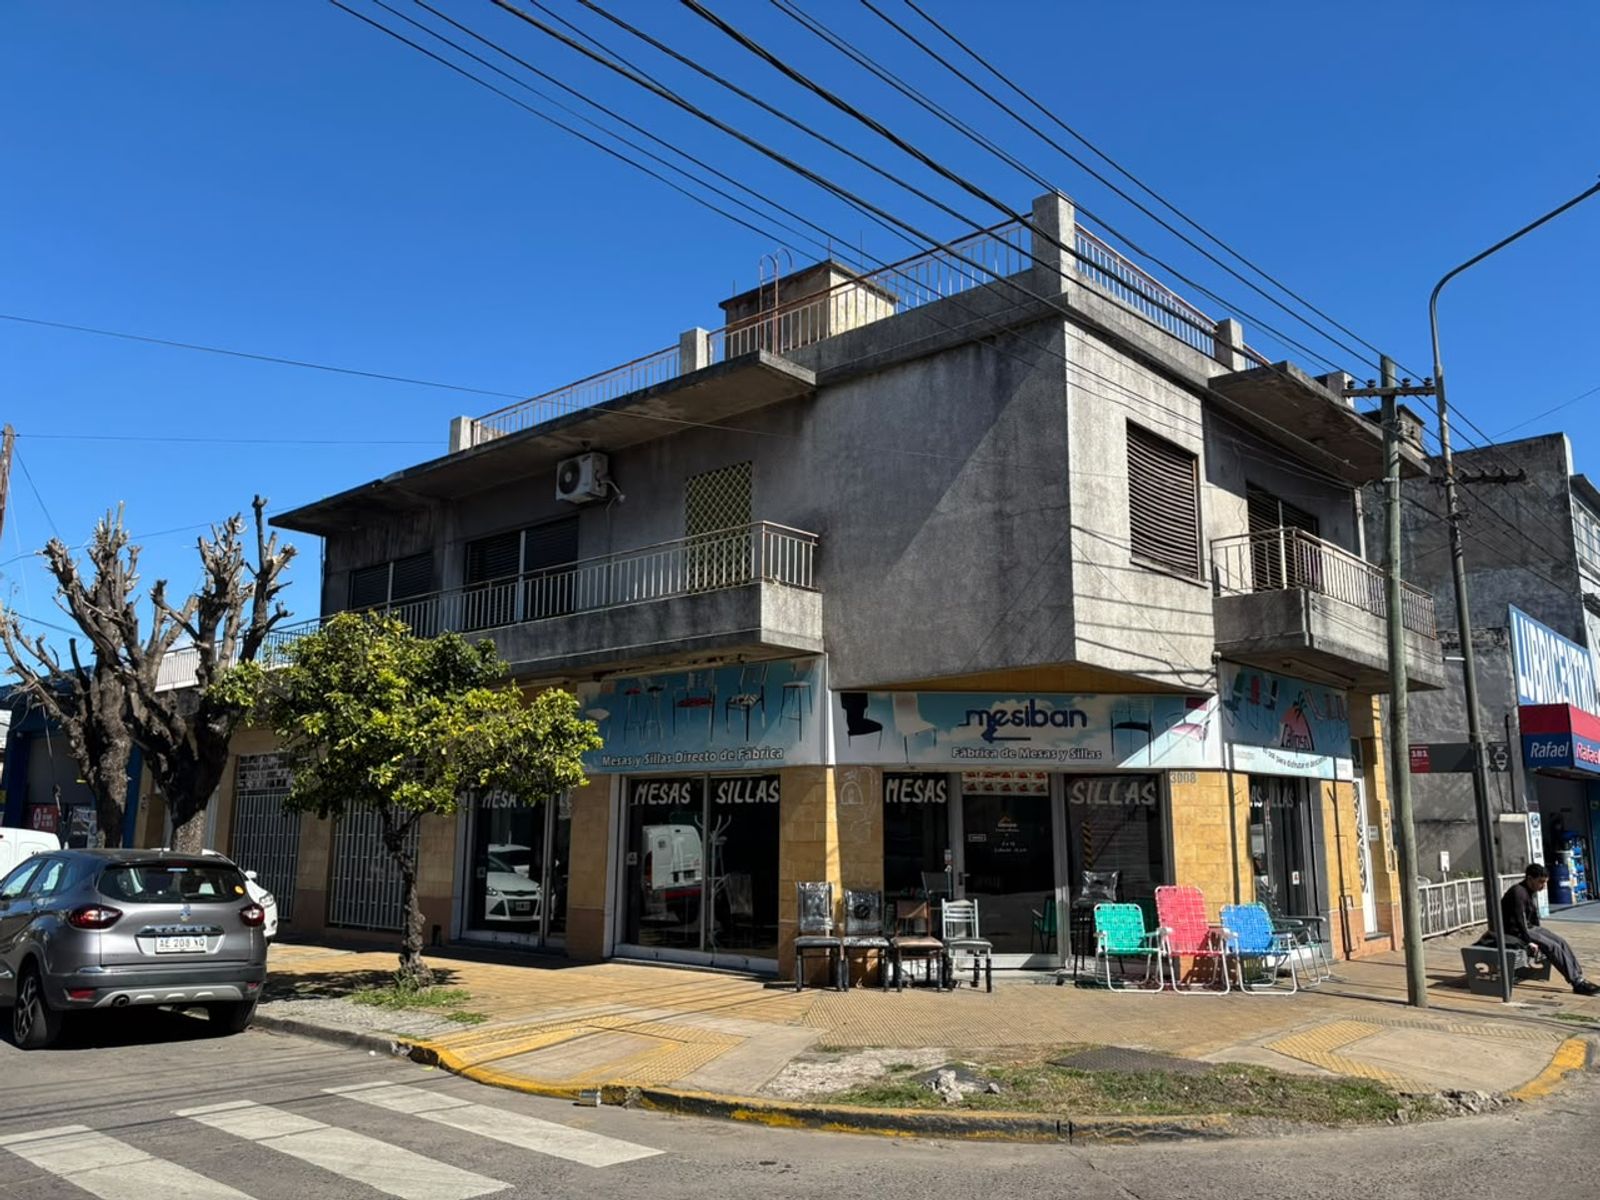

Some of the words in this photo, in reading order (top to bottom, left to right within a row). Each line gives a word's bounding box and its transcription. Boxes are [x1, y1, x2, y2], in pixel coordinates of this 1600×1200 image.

[1511, 610, 1599, 718] LUBRICENTRO
[957, 699, 1088, 728] mesiban
[601, 755, 633, 767] Mesas
[634, 756, 642, 768] y
[643, 751, 673, 764] Sillas
[674, 751, 718, 764] Directo
[720, 749, 736, 761] de
[1000, 747, 1017, 760] de
[1018, 748, 1057, 760] Mesas
[1057, 750, 1068, 762] y
[1068, 748, 1103, 760] Sillas
[1530, 740, 1570, 759] Rafael
[634, 781, 692, 806] MESAS
[715, 779, 780, 804] SILLAS
[885, 778, 947, 804] MESAS
[1069, 781, 1156, 806] SILLAS
